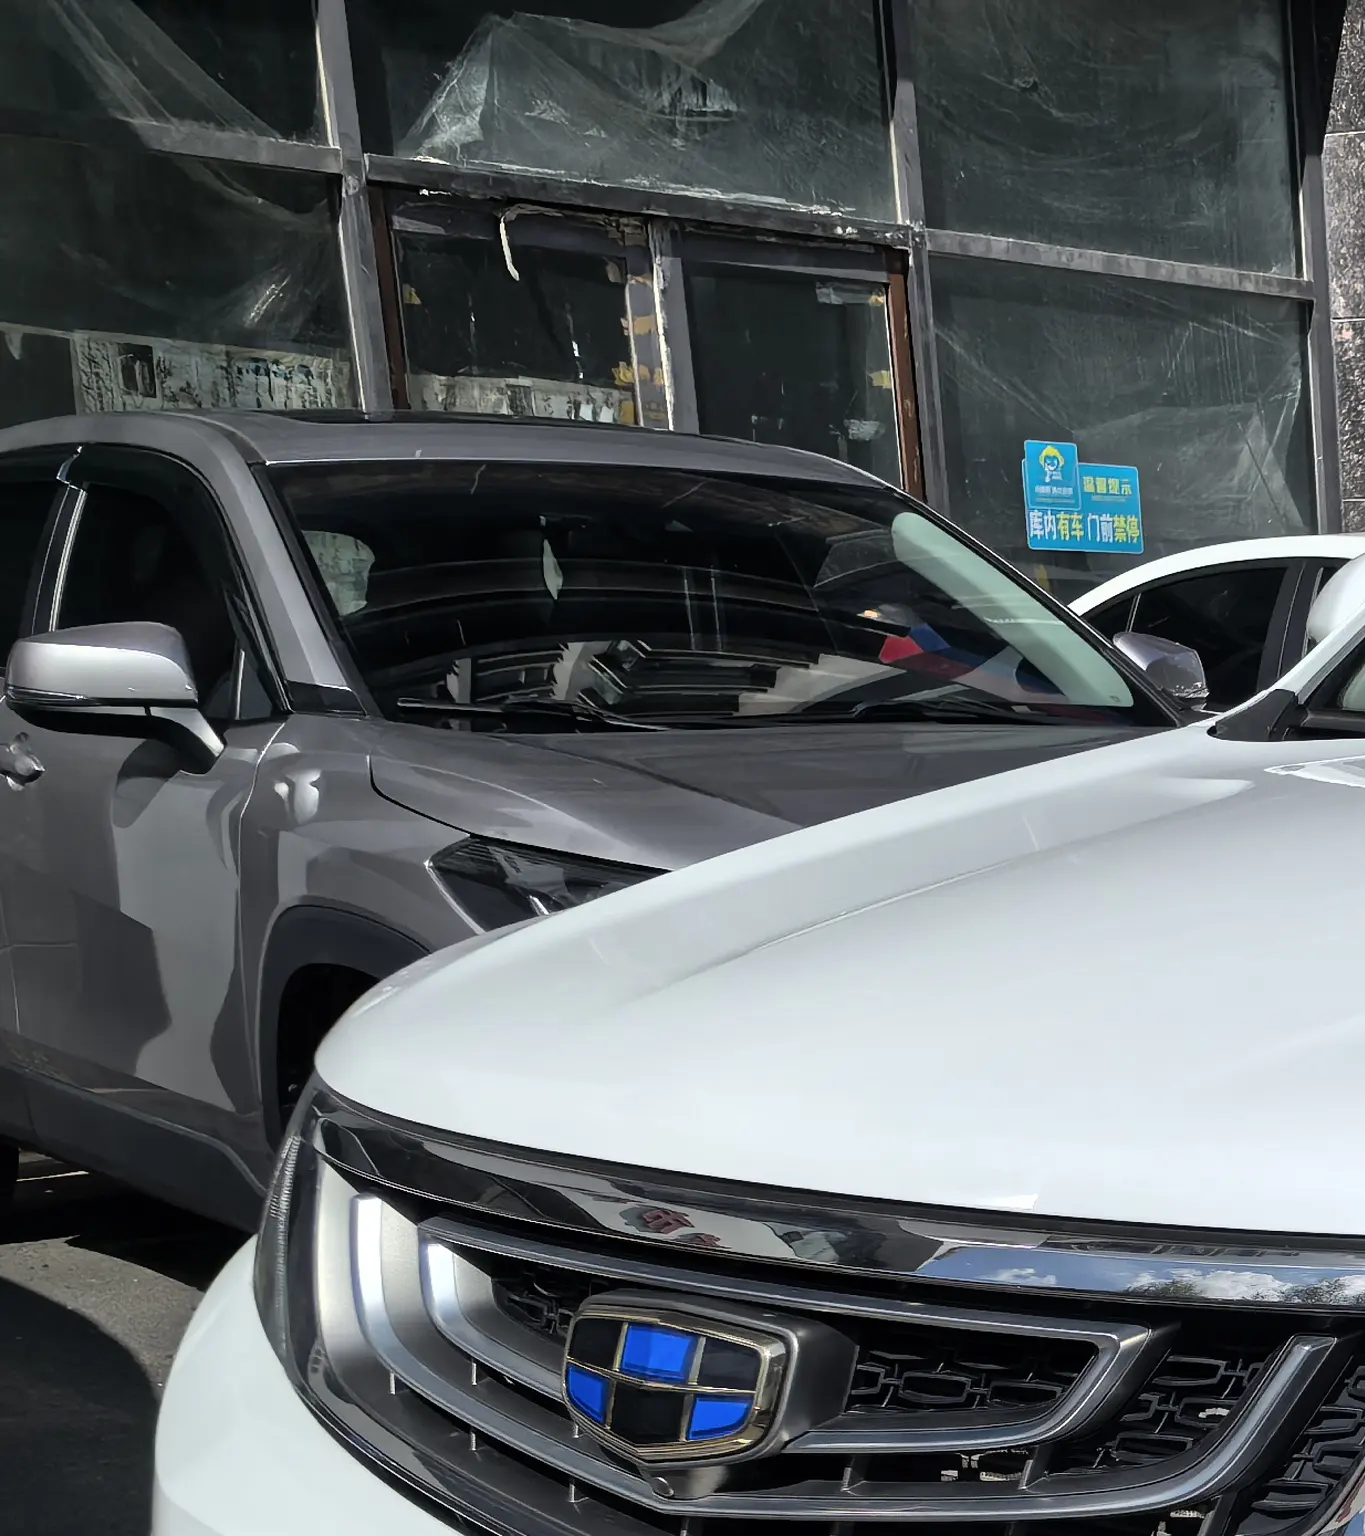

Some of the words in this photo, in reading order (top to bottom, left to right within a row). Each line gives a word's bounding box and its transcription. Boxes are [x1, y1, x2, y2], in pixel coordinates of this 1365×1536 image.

[1029, 509, 1084, 541] 库内有车
[1087, 512, 1140, 543] 门前禁停
